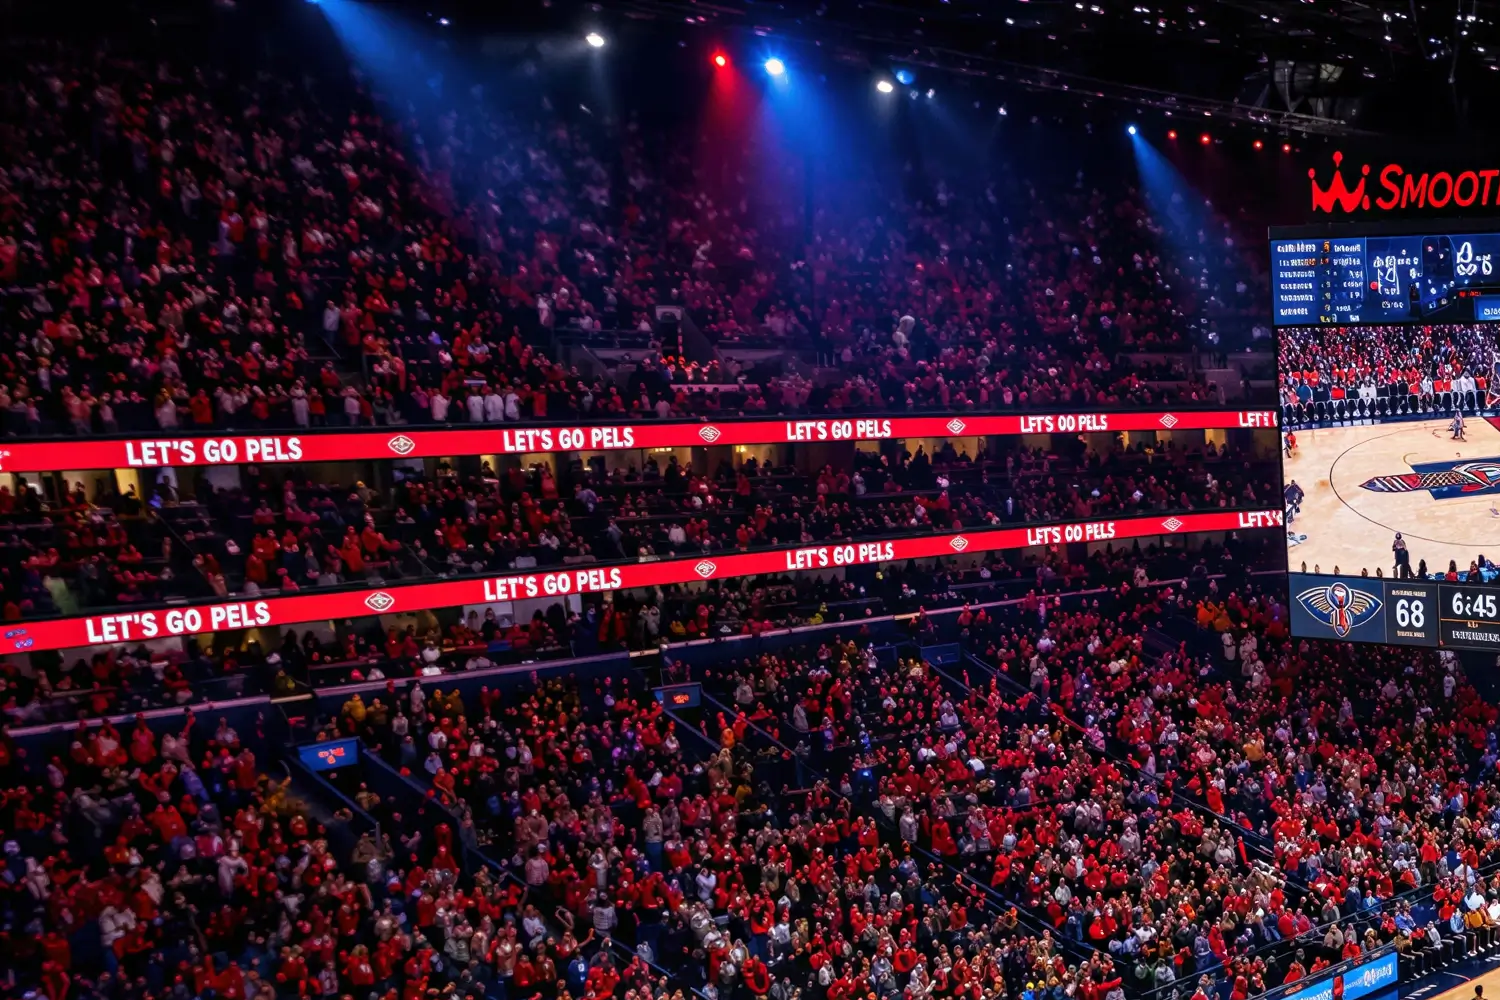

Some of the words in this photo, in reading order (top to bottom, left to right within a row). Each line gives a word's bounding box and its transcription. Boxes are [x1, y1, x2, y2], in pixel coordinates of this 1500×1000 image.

[503, 429, 553, 451] LET'S
[558, 428, 585, 450] GO
[591, 427, 635, 448] PELS
[786, 421, 828, 441] LET'S
[831, 421, 852, 439] GO
[856, 420, 892, 438] PELS
[126, 440, 196, 466] LET'S
[203, 439, 238, 463] GO
[245, 437, 303, 461] PELS
[786, 548, 829, 570] LET'S
[833, 545, 855, 566] GO
[858, 542, 895, 563] PELS
[483, 576, 538, 601] LET'S
[543, 573, 571, 595] GO
[576, 568, 622, 592] PELS
[86, 612, 159, 643] LET'S
[166, 608, 202, 634] GO
[210, 601, 271, 630] PELS
[1396, 599, 1425, 628] 68
